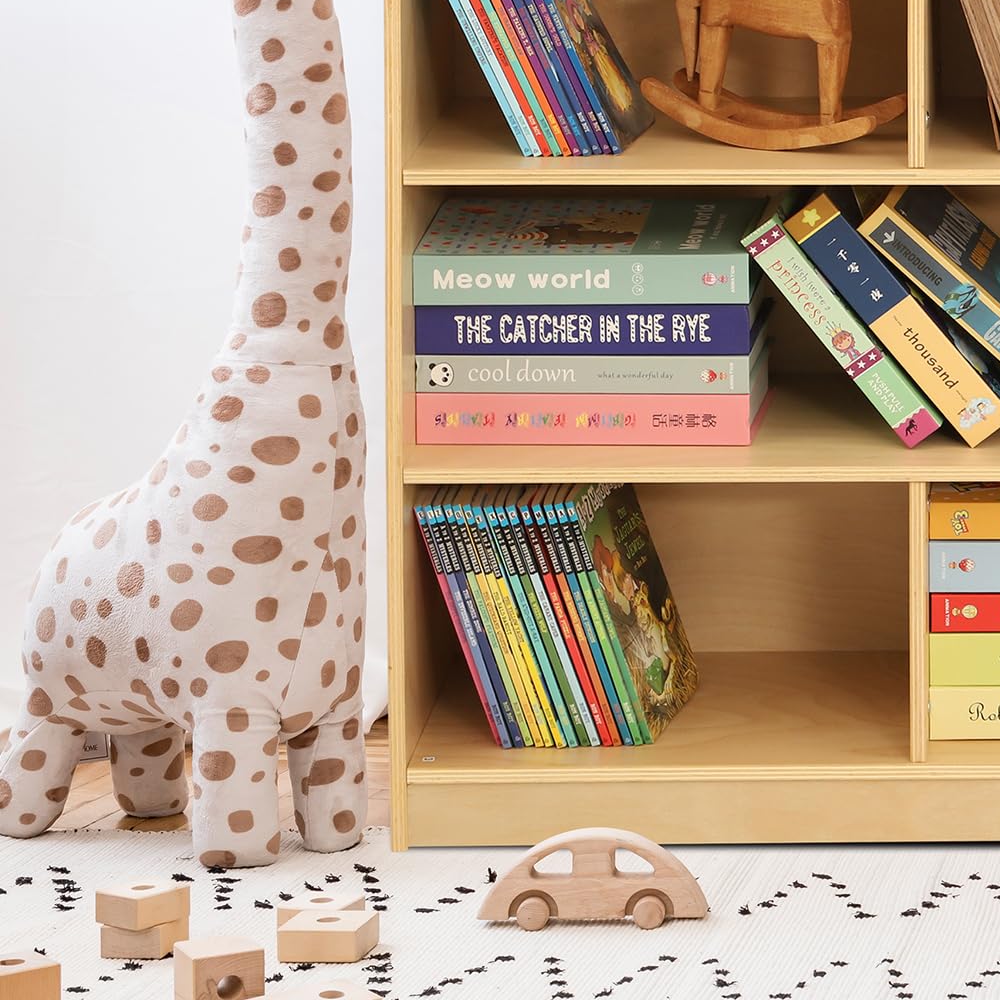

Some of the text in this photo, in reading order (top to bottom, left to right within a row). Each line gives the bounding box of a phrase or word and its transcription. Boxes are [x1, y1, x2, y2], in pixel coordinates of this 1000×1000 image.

[827, 238, 884, 302] 一千零一夜
[891, 237, 943, 287] INTRODUCING
[433, 269, 610, 290] Meow world
[767, 259, 826, 326] princess
[454, 313, 712, 344] THE CATCHER IN THE RYE
[468, 359, 576, 382] cool down
[903, 327, 959, 390] thousand
[598, 371, 615, 379] what
[622, 371, 660, 381] wonderful
[661, 371, 674, 381] day
[652, 413, 717, 428] 格林童话
